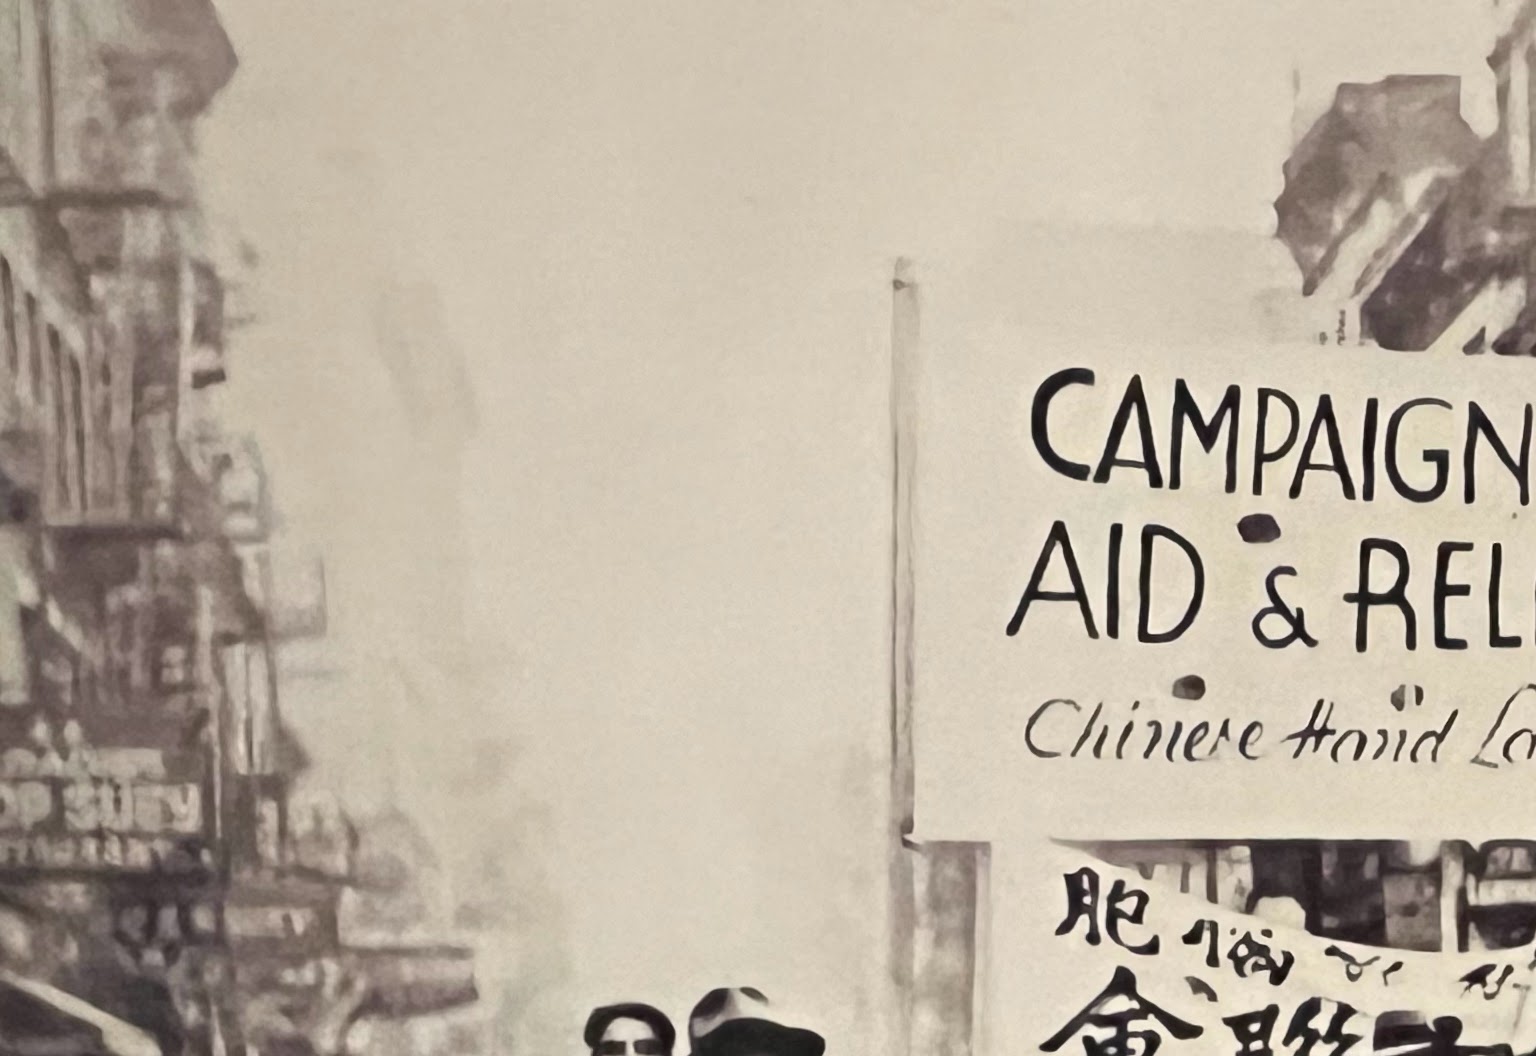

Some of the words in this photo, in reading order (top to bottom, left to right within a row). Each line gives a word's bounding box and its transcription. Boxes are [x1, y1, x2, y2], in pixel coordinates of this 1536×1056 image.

[1030, 366, 1535, 507] CAMPAIGN
[1005, 519, 1206, 645] AID
[1250, 564, 1320, 651] &
[1024, 697, 1265, 763] Chinese
[1280, 697, 1460, 764] Hand
